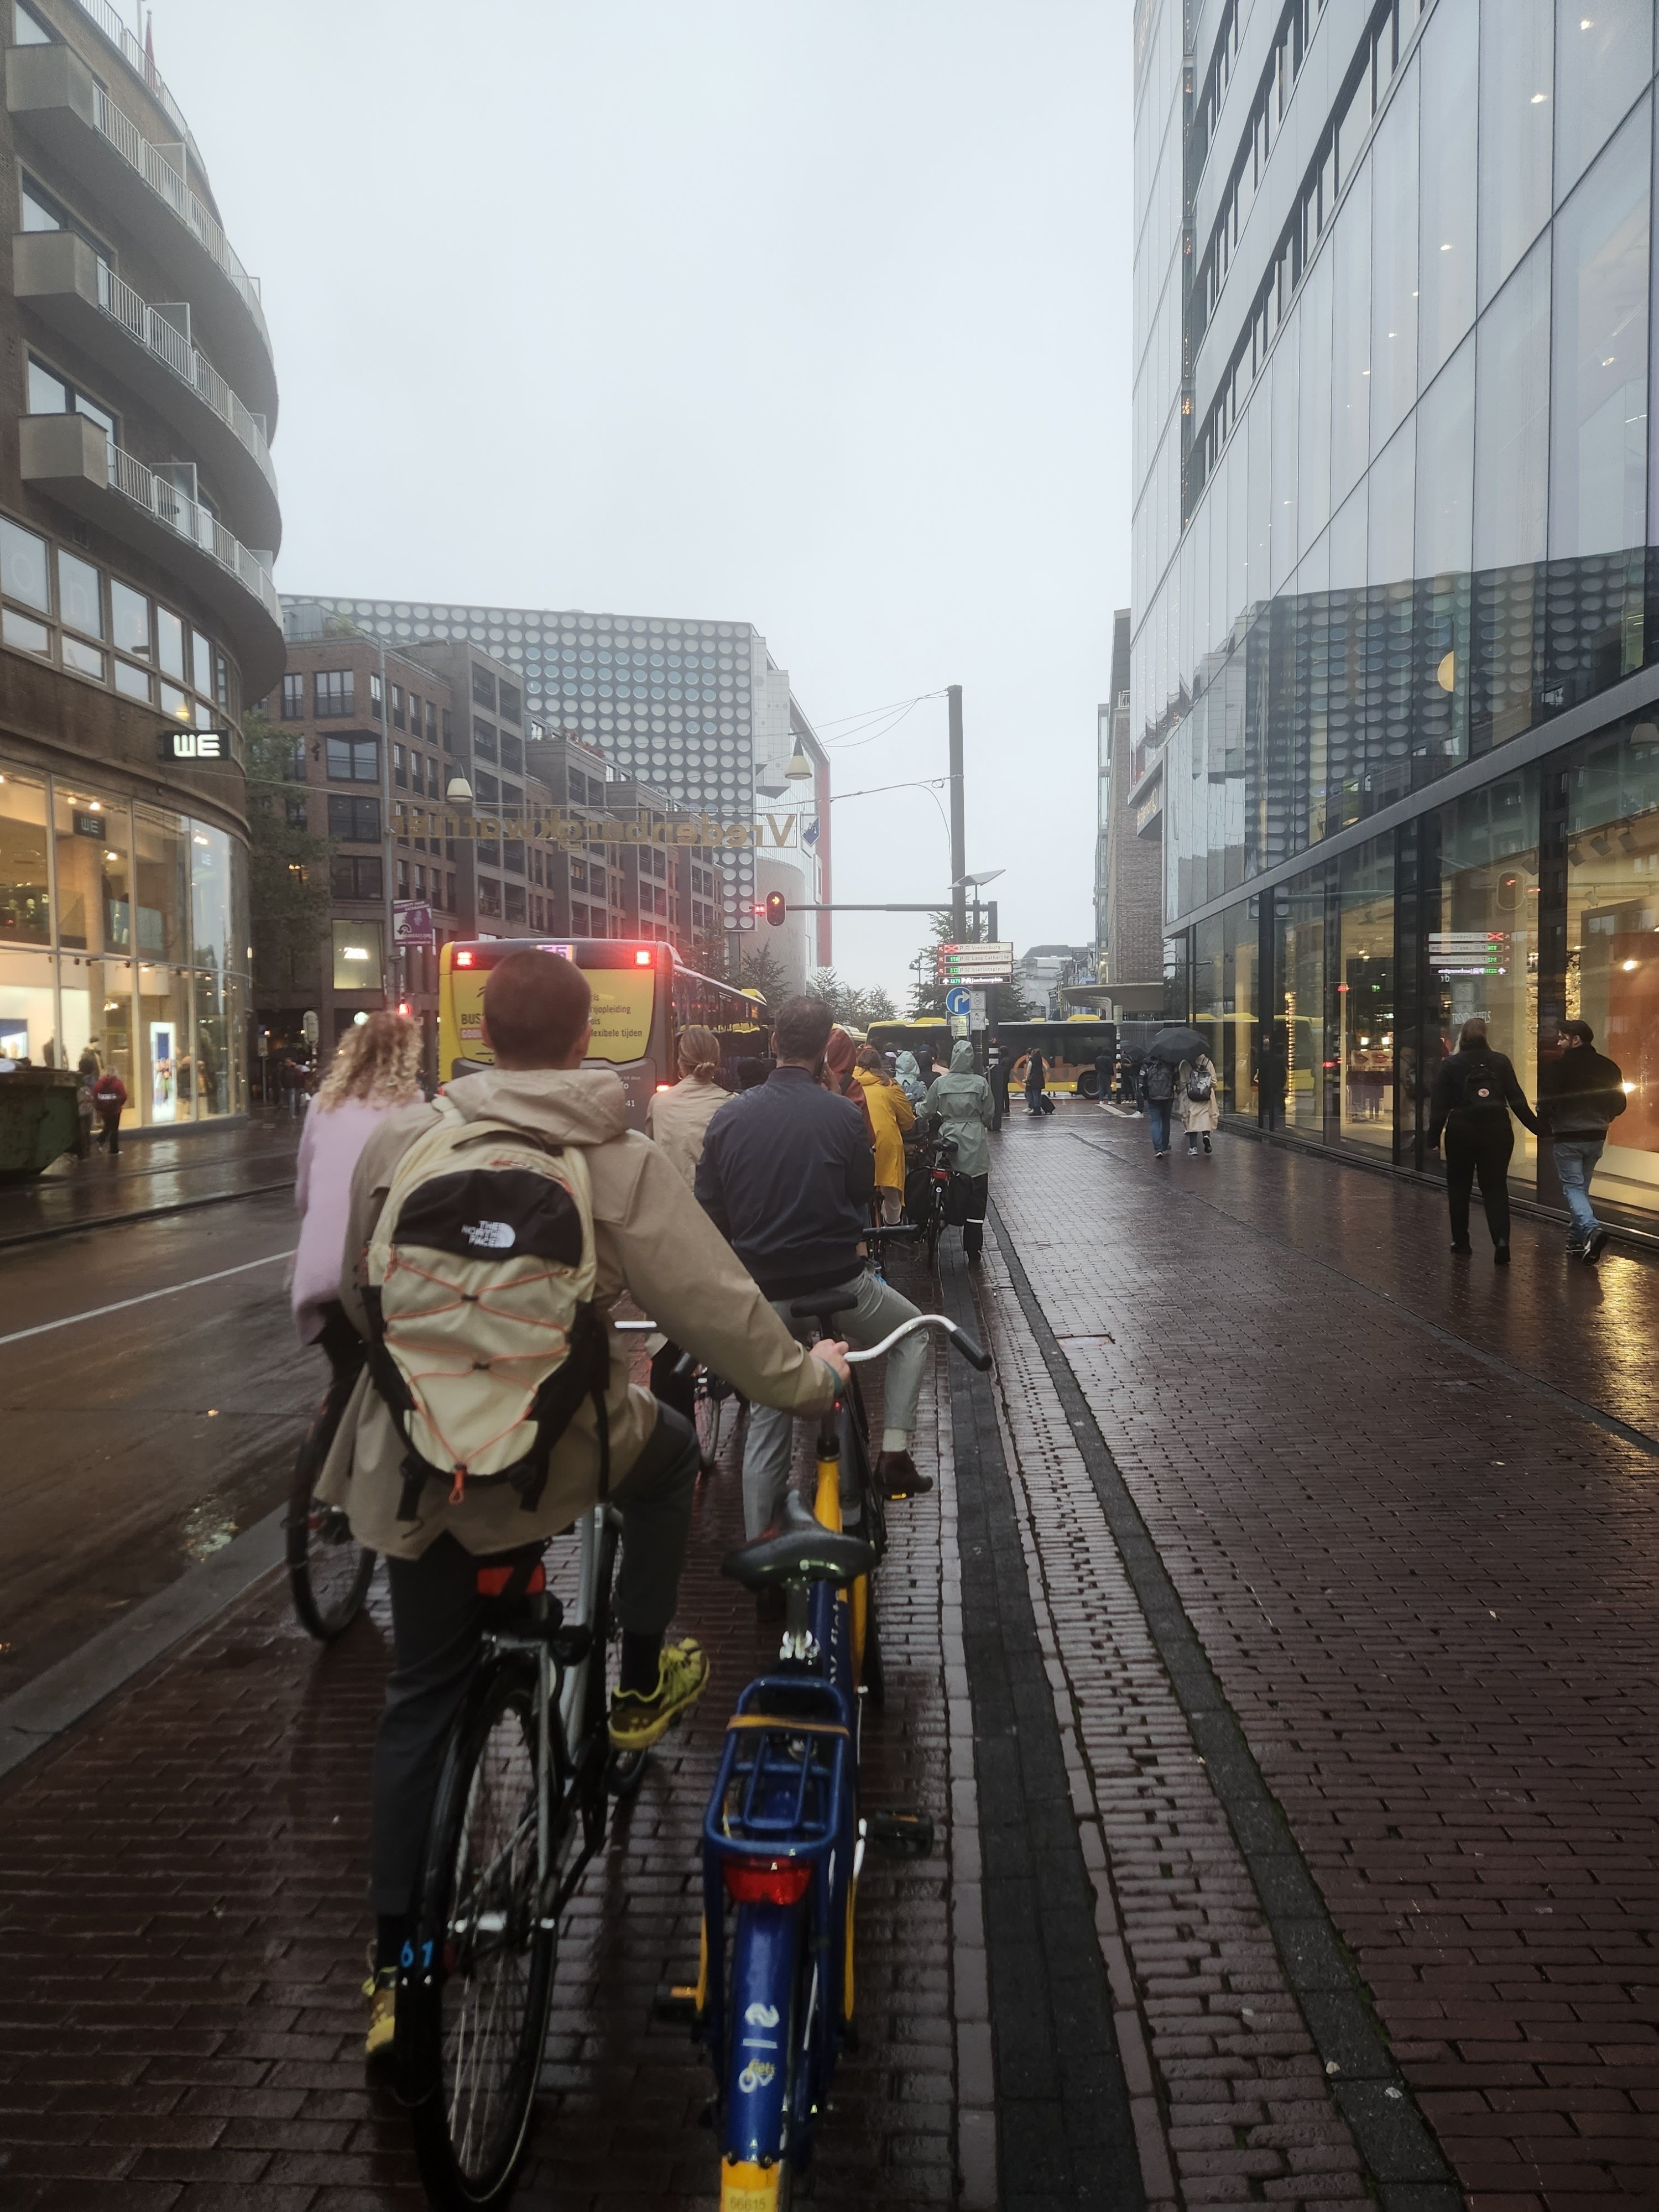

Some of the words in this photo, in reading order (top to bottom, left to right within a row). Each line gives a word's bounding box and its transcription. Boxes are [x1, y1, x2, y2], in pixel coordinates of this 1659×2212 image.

[173, 734, 220, 757] WE
[81, 817, 100, 834] WE
[590, 1005, 632, 1014] rijopleiding
[461, 1013, 484, 1025] BUS
[591, 1029, 619, 1037] lexibele
[622, 1029, 643, 1038] tijden
[461, 1224, 498, 1238] NORTH
[478, 1220, 500, 1230] THE
[468, 1234, 497, 1248] FACE
